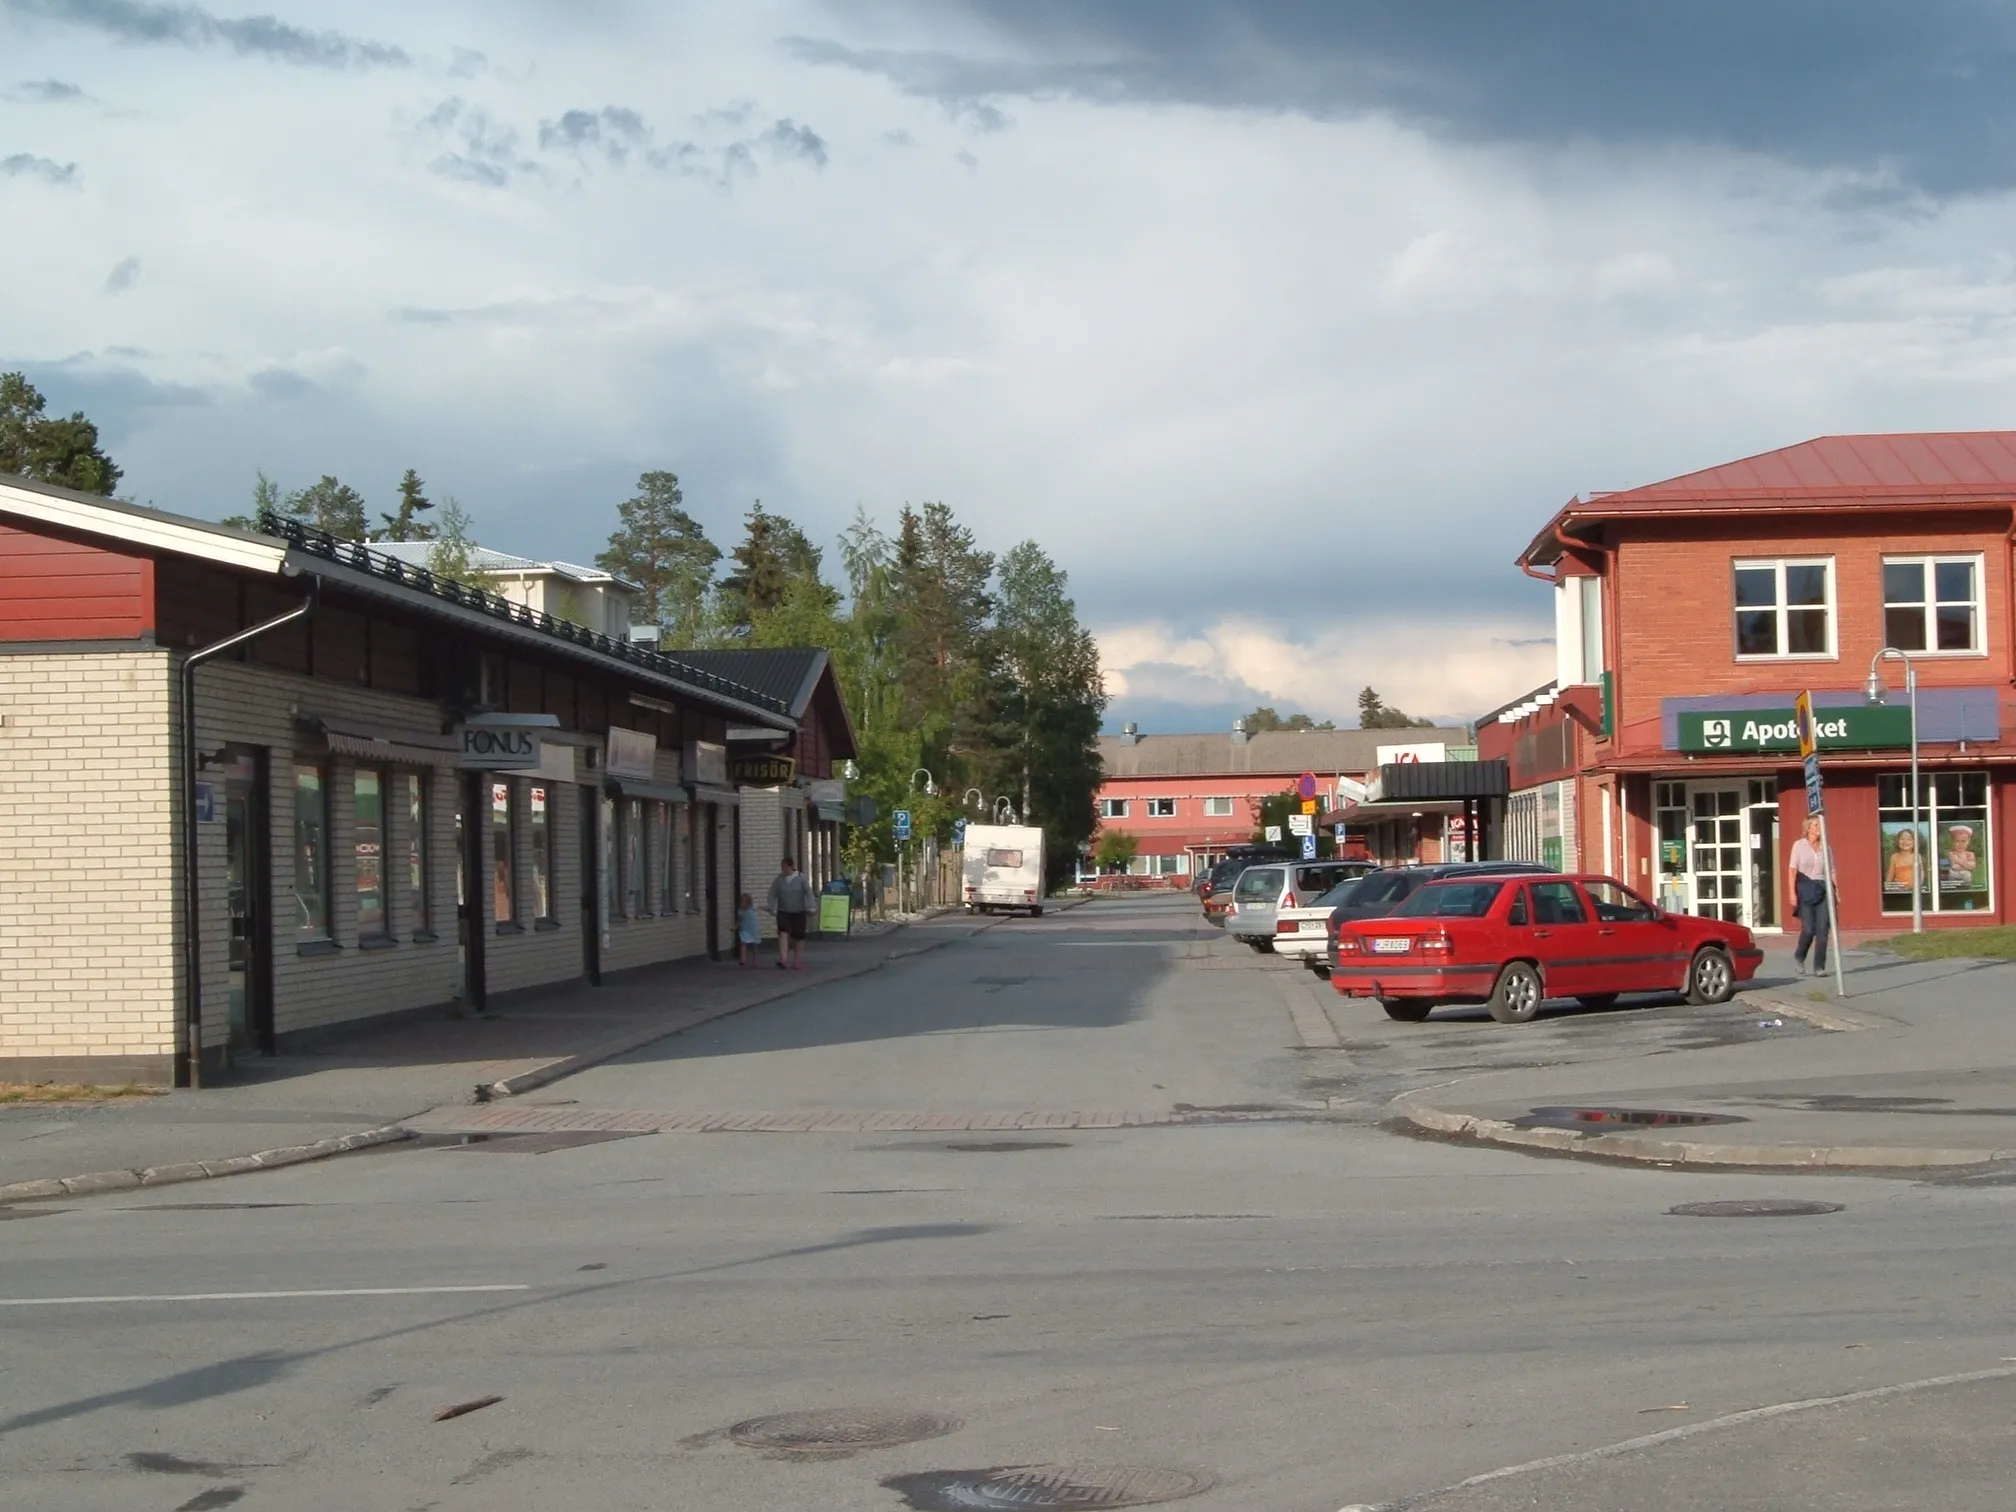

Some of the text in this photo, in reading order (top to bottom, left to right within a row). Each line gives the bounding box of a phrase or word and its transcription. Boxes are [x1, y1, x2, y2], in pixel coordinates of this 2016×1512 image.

[464, 730, 533, 755] FONUS
[1742, 717, 1848, 746] Apotket
[735, 760, 788, 778] FRISÖR
